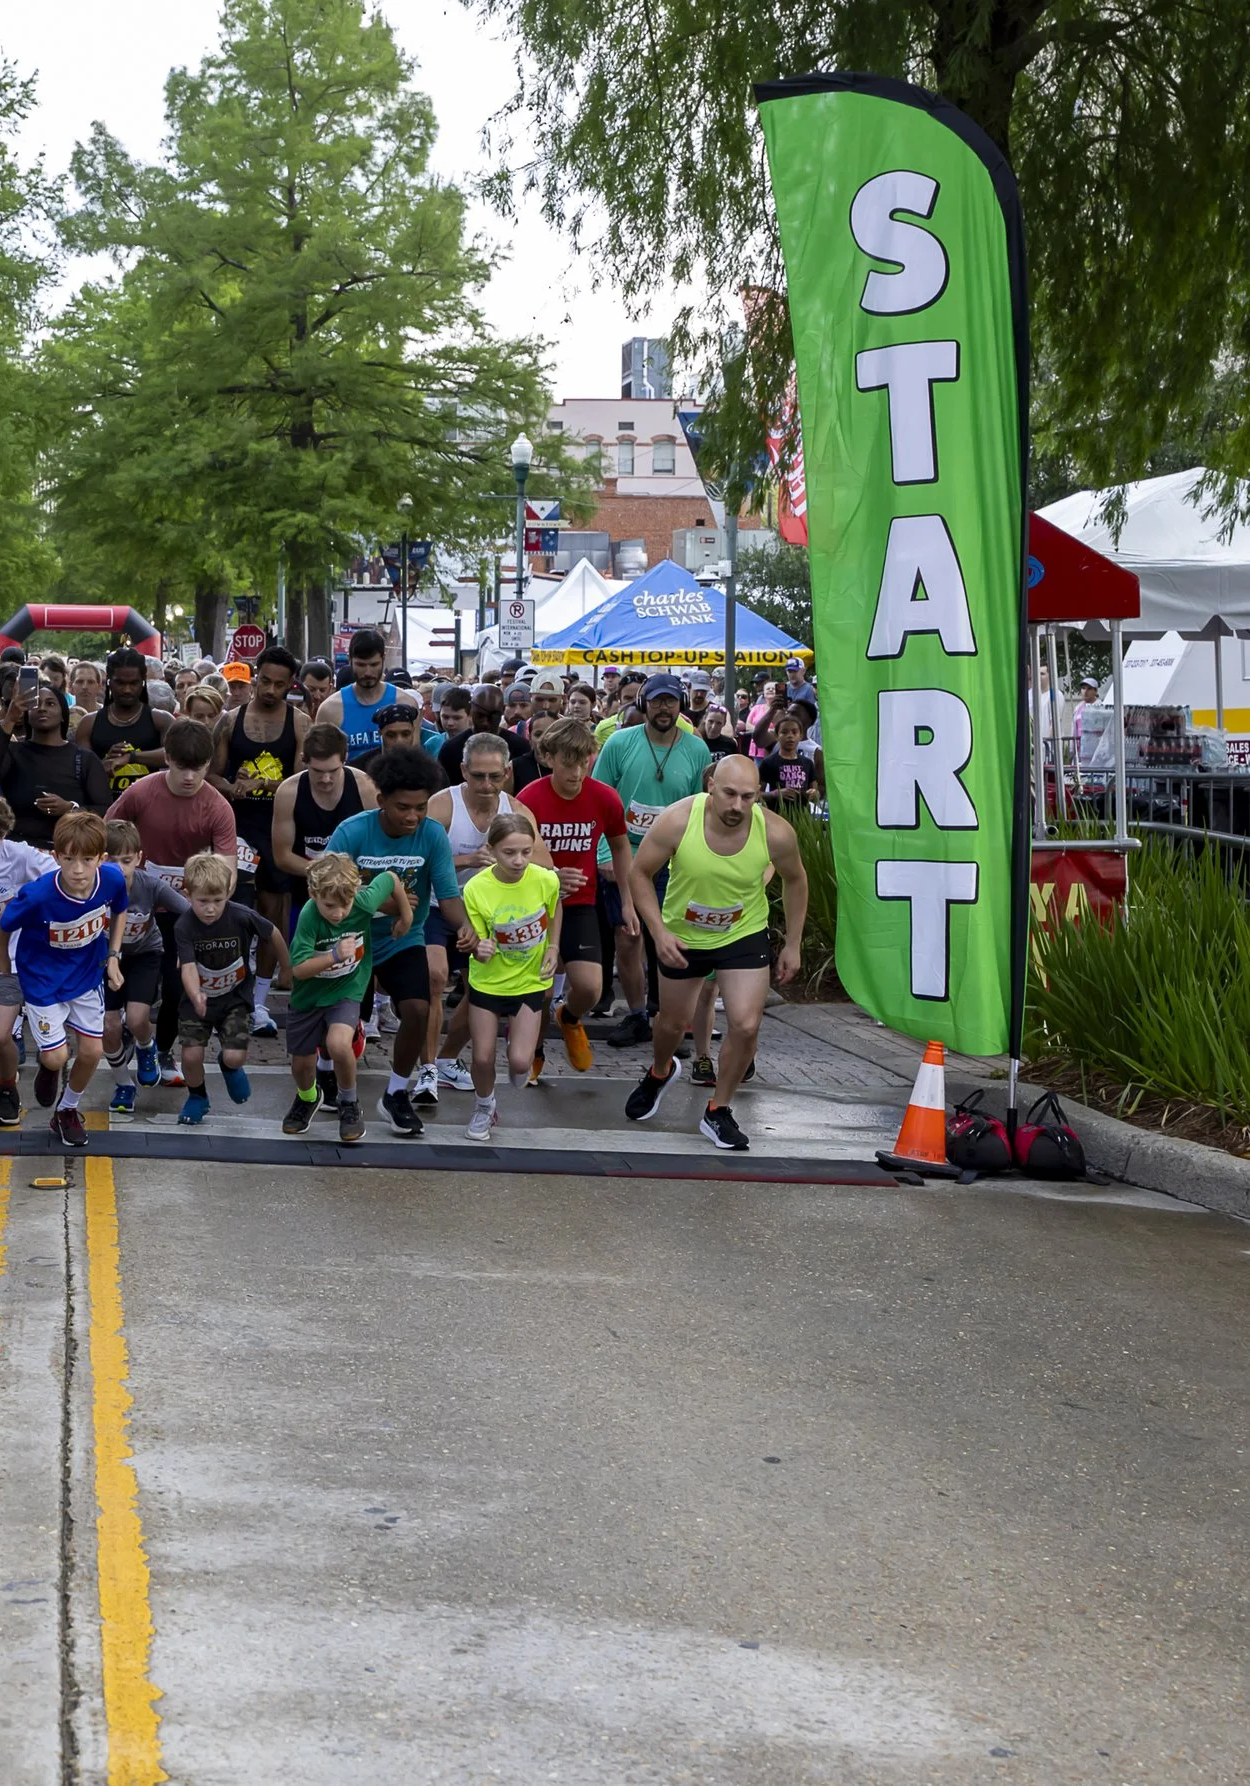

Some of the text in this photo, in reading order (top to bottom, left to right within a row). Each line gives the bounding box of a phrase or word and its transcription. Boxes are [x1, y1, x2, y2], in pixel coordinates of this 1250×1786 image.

[848, 169, 979, 1000] START
[634, 589, 702, 606] charles
[636, 602, 710, 618] SCHWAB
[670, 613, 715, 626] BANK
[235, 634, 262, 648] STOP
[583, 650, 793, 663] CASH TOP-UP SATION
[1225, 742, 1250, 754] SALES
[779, 771, 806, 781] DANCE
[632, 812, 656, 827] 32
[695, 911, 734, 926] 332
[54, 917, 103, 942] 1210
[505, 921, 542, 944] 338
[201, 972, 238, 989] 248
